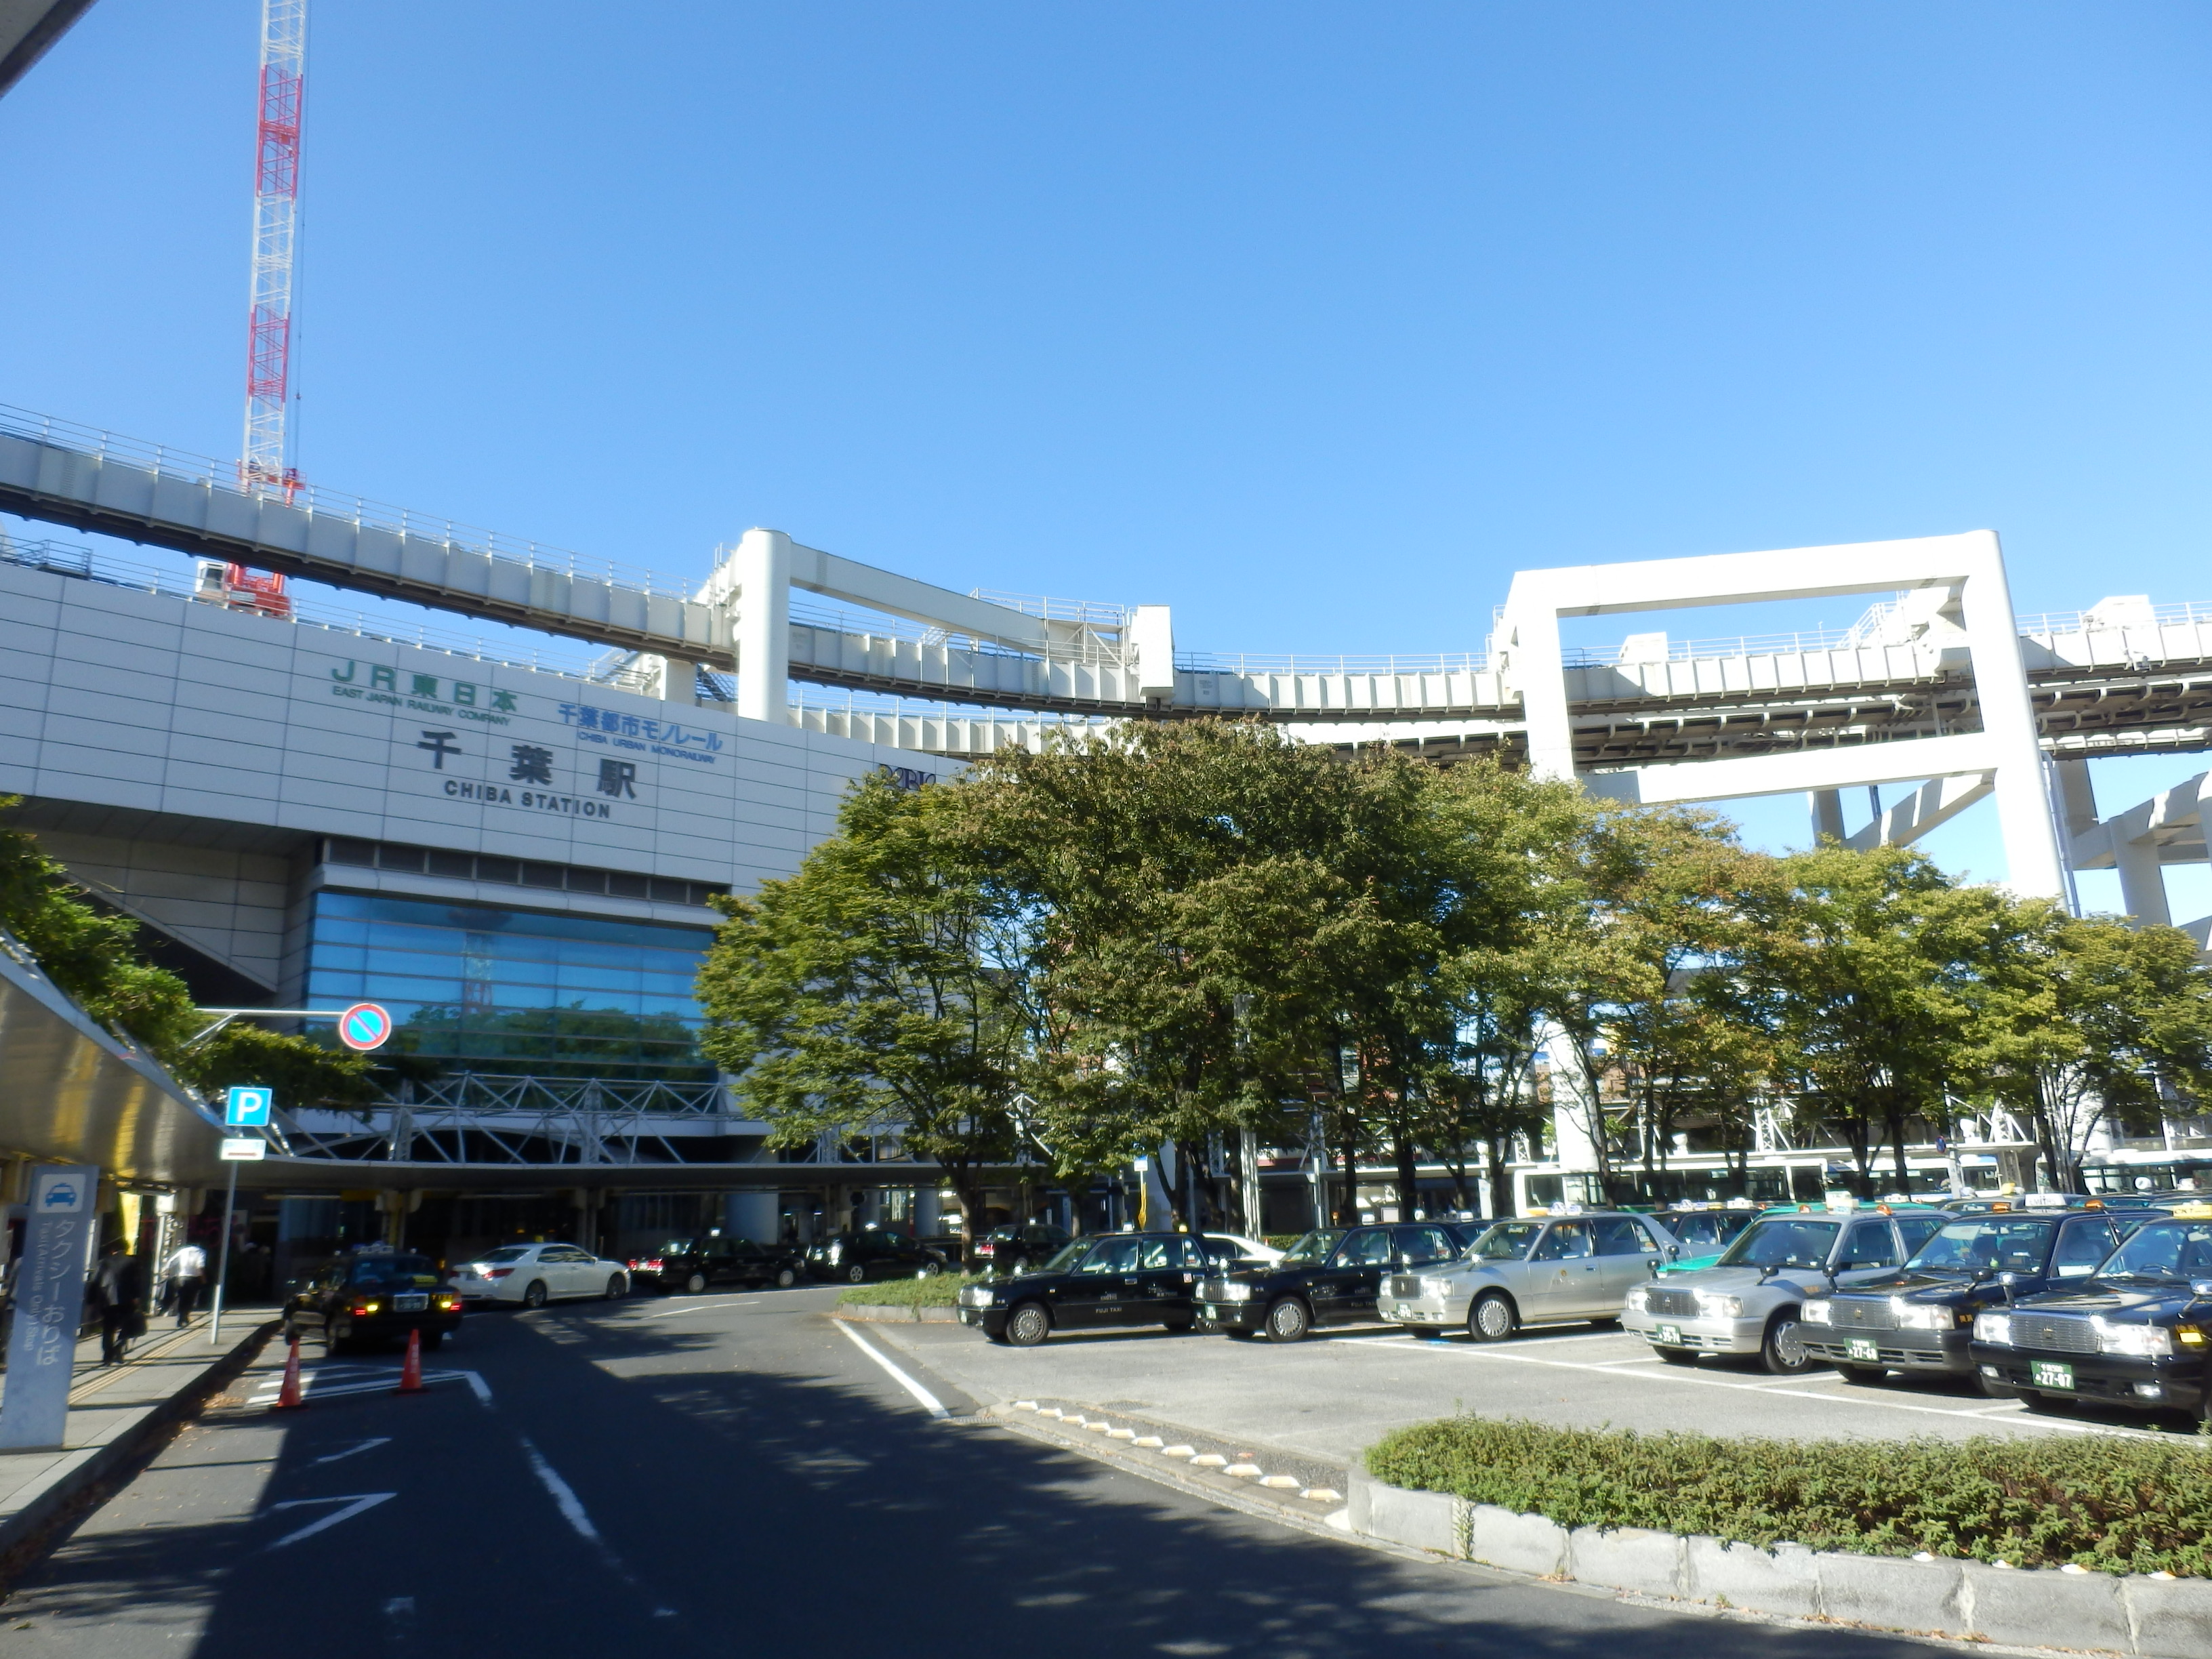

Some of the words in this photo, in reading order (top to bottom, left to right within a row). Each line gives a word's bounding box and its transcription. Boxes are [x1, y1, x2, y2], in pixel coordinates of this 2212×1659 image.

[331, 661, 518, 712] JR東日本
[332, 686, 364, 699] EAST
[367, 692, 403, 707] JAPAN
[407, 699, 455, 716] RAILWAY
[458, 709, 510, 726] COMPANY
[558, 703, 724, 752] 千葉都市モノレール
[578, 731, 608, 745] CHIBA
[613, 738, 646, 752] URBAN
[651, 745, 716, 764] MONORAILWAY
[417, 731, 637, 800] 千葉駅
[445, 780, 512, 804] CHIBA
[521, 792, 611, 819] STATION
[236, 1091, 263, 1122] P
[37, 1221, 76, 1366] タクシーおりば
